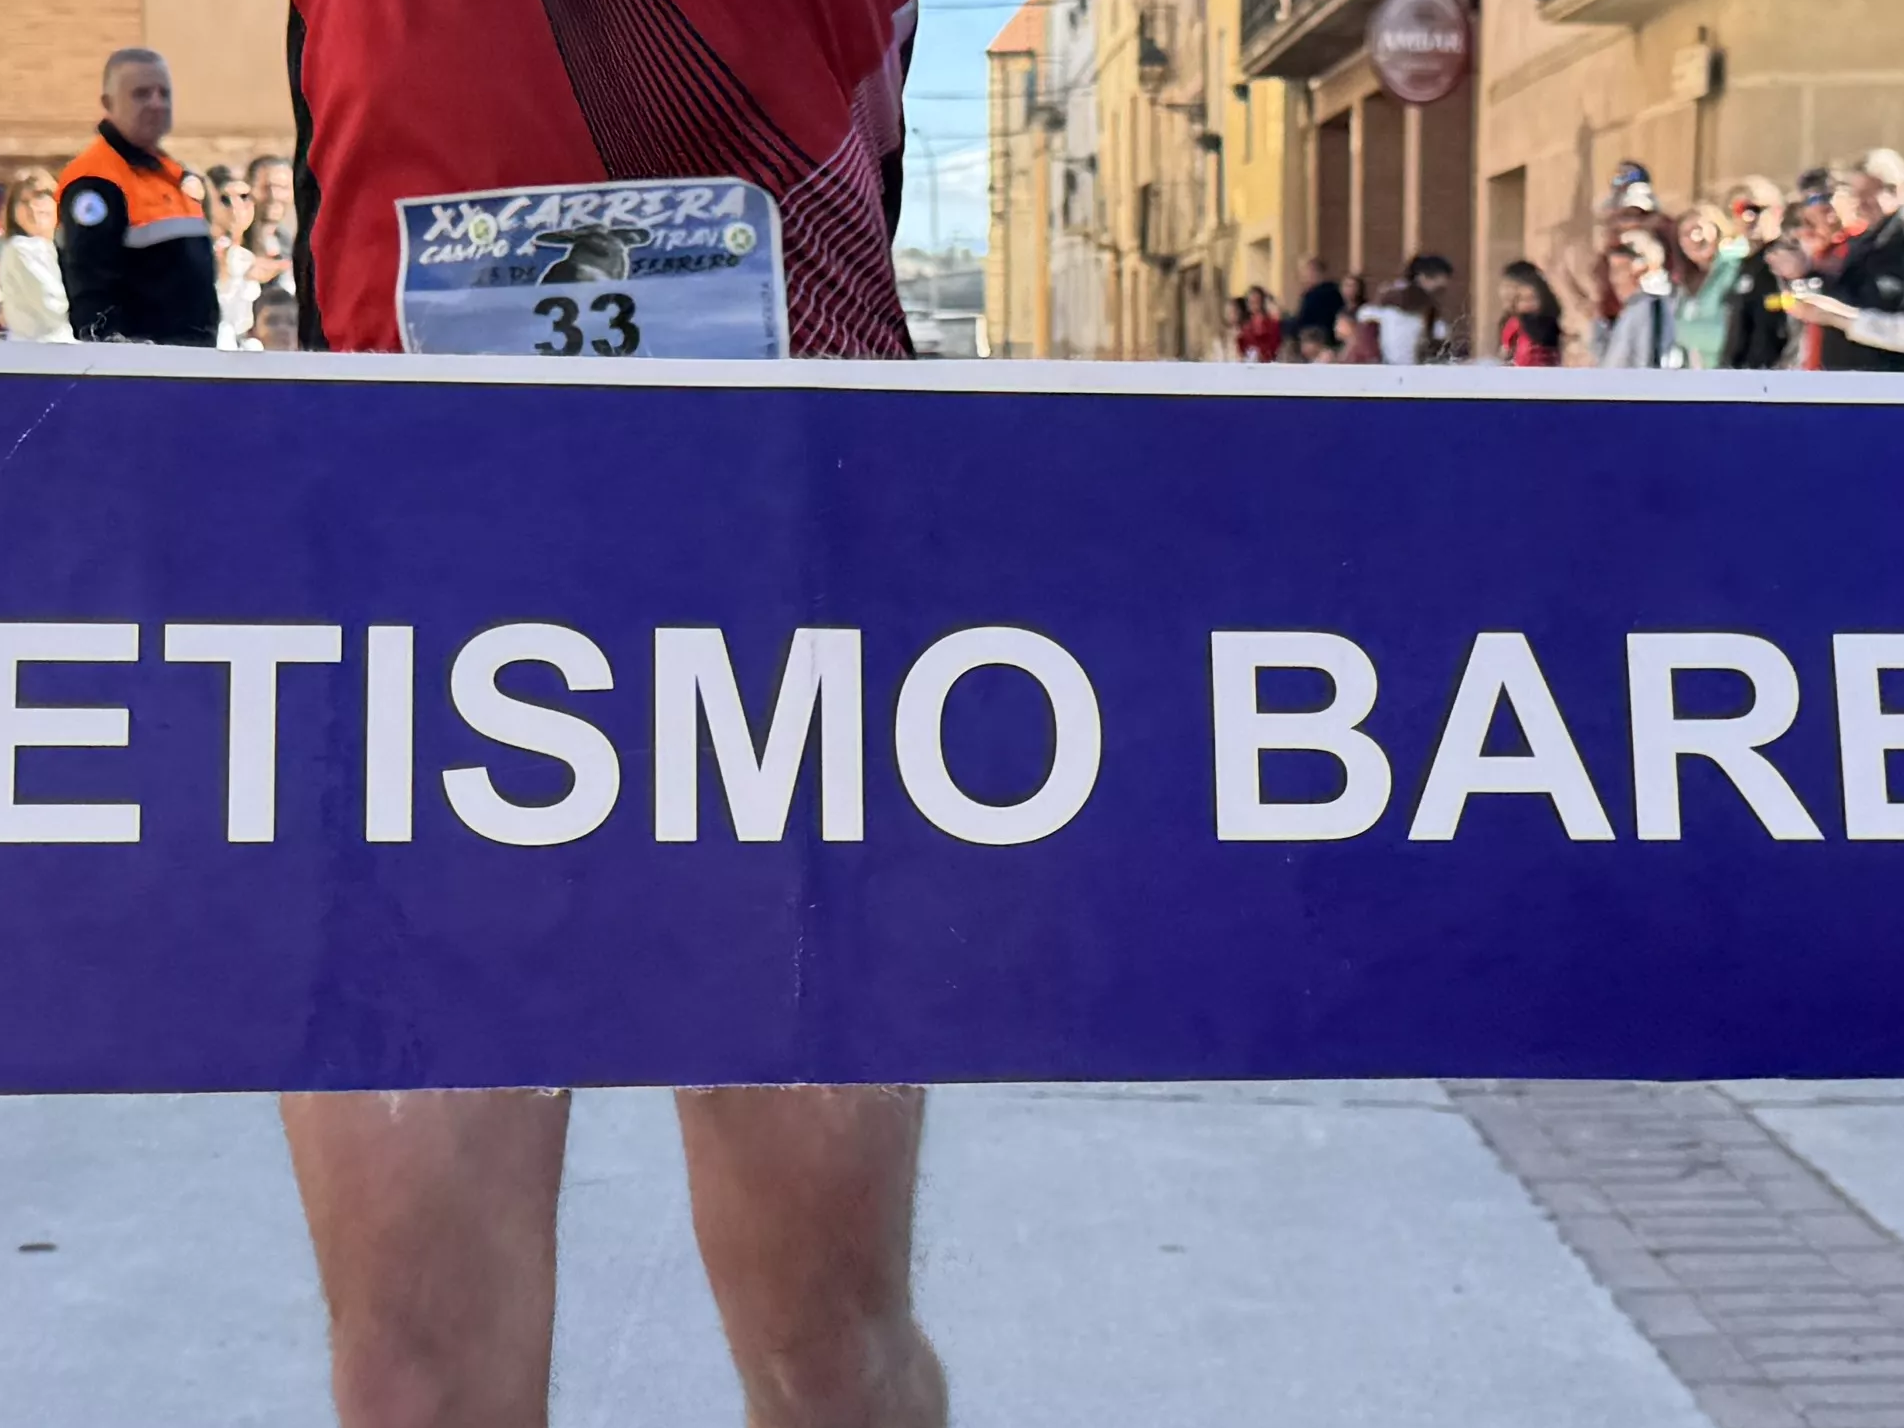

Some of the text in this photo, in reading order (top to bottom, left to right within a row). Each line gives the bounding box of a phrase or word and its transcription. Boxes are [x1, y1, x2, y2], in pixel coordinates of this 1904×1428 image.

[497, 185, 747, 231] CARRERA
[652, 227, 726, 252] TRAV
[533, 293, 641, 356] 33
